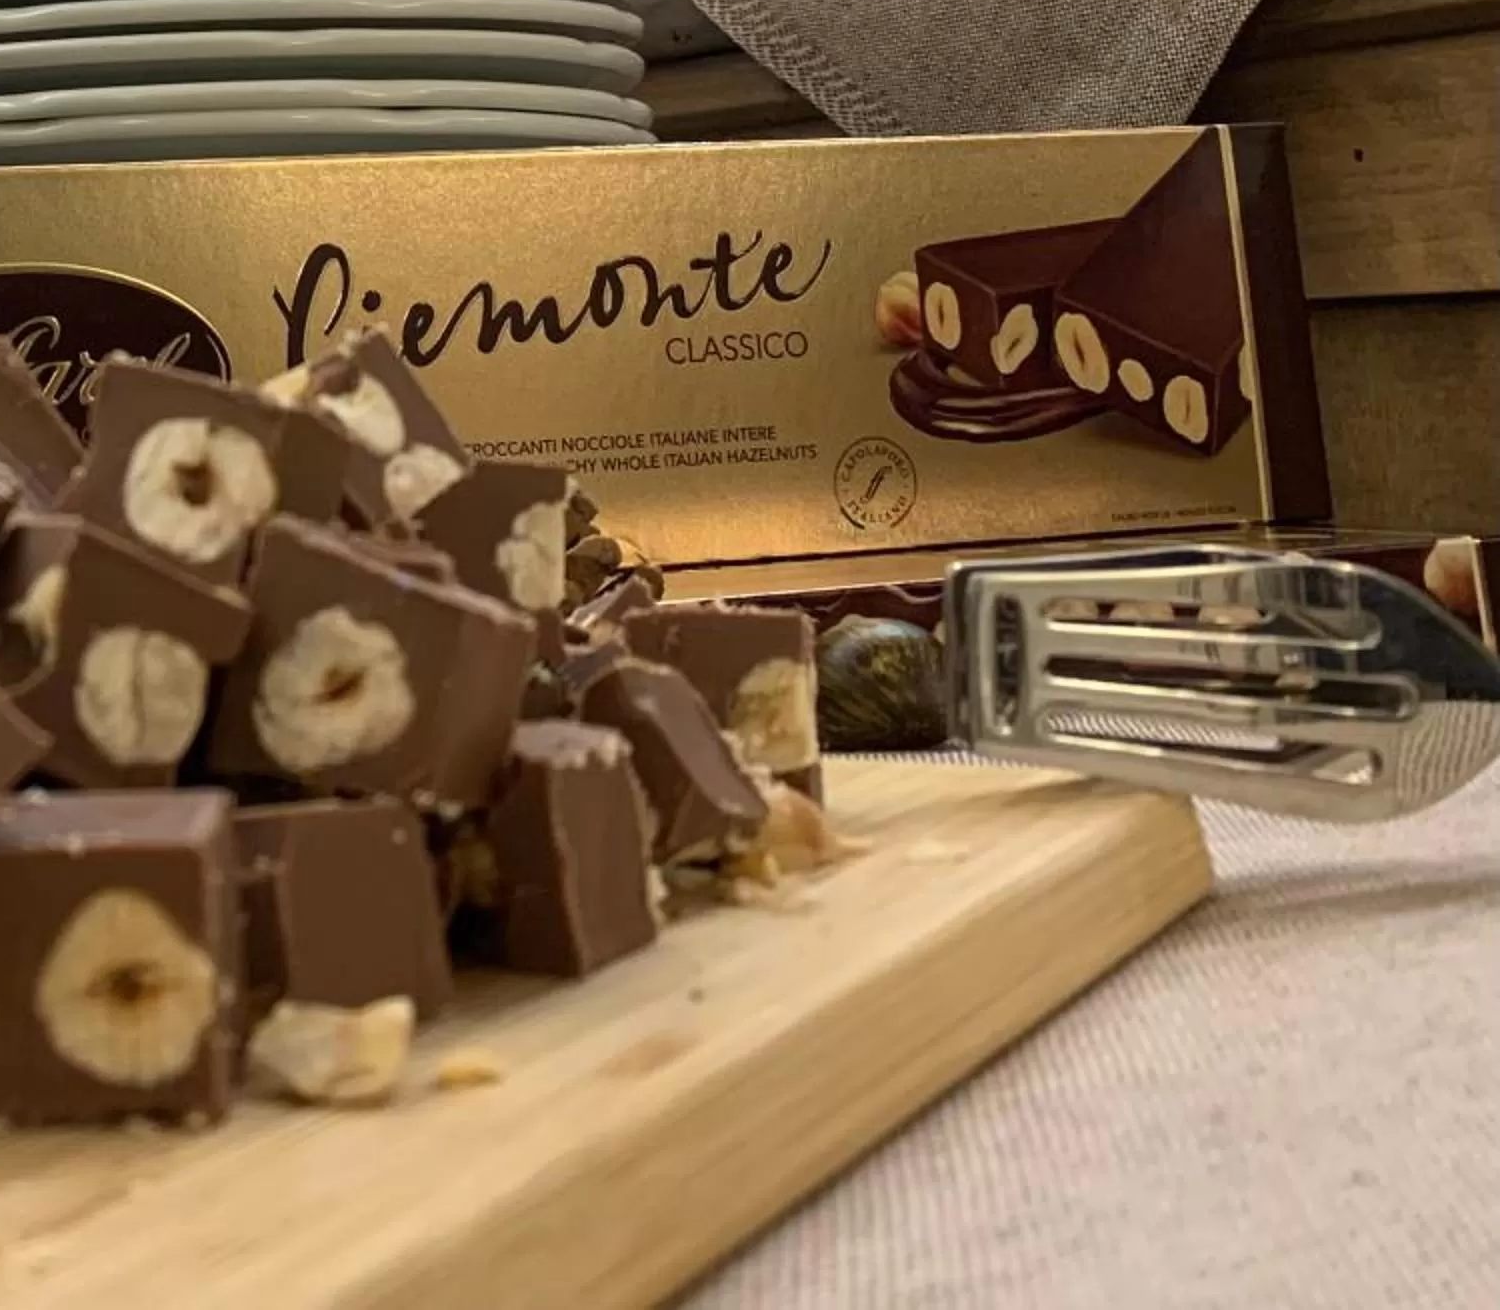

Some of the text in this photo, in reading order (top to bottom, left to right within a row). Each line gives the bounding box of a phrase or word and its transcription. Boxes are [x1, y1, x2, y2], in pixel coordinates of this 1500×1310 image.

[665, 331, 809, 365] CLASSICO
[561, 434, 645, 452] NOCCIOLE
[650, 430, 718, 448] ITALIANE
[723, 426, 777, 443] INTERE
[601, 454, 661, 472] WHOLE
[663, 450, 723, 468] ITALIAN
[727, 443, 818, 464] HAZELNUTS
